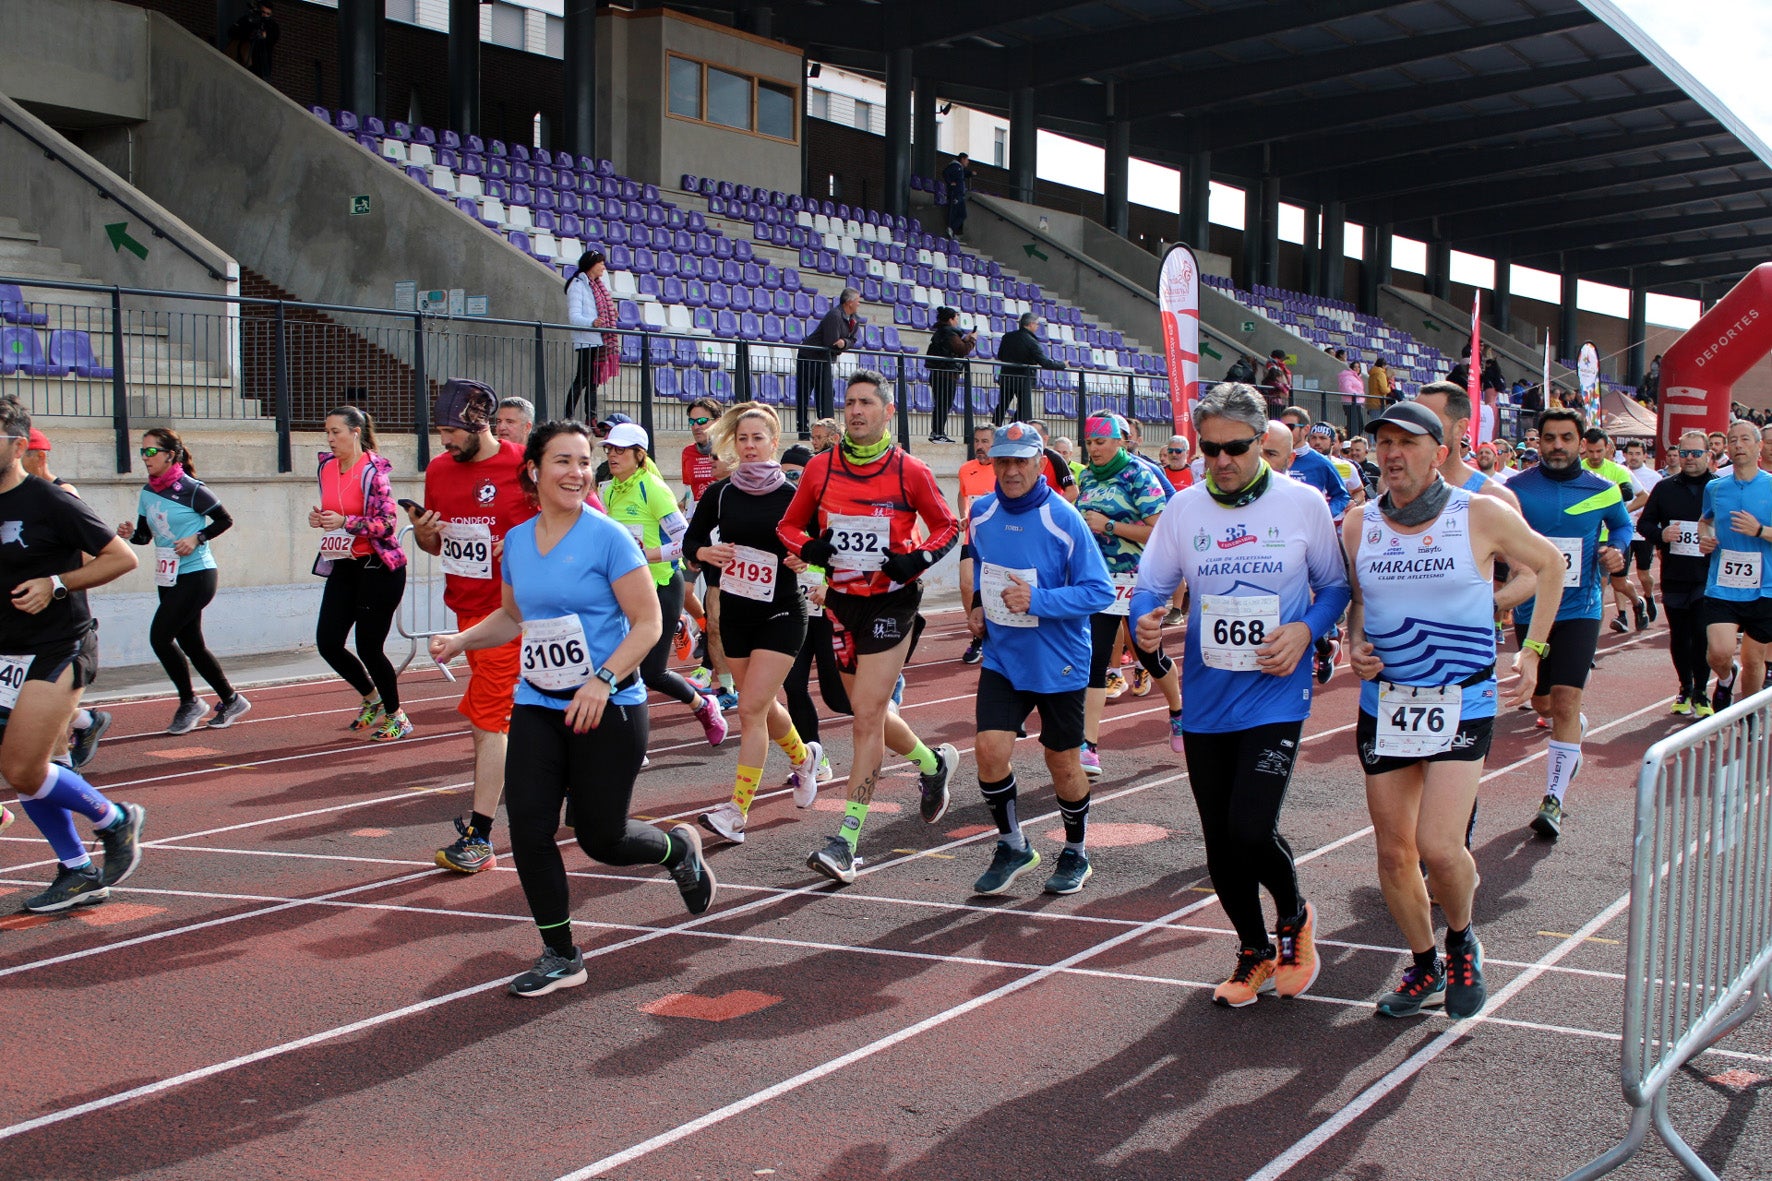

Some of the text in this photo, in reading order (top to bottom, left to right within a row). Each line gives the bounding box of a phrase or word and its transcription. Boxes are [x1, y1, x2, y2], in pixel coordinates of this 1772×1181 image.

[1695, 308, 1760, 367] DEPORTES
[320, 536, 352, 551] 2002
[837, 531, 879, 553] 332
[1226, 523, 1247, 542] 35
[443, 538, 488, 562] 3049
[724, 559, 773, 584] 2193
[1198, 561, 1283, 576] MARACENA
[1369, 557, 1455, 573] MARACENA
[1724, 561, 1753, 577] 573
[1214, 618, 1265, 646] 668
[524, 639, 585, 670] 3106
[1391, 706, 1445, 732] 476
